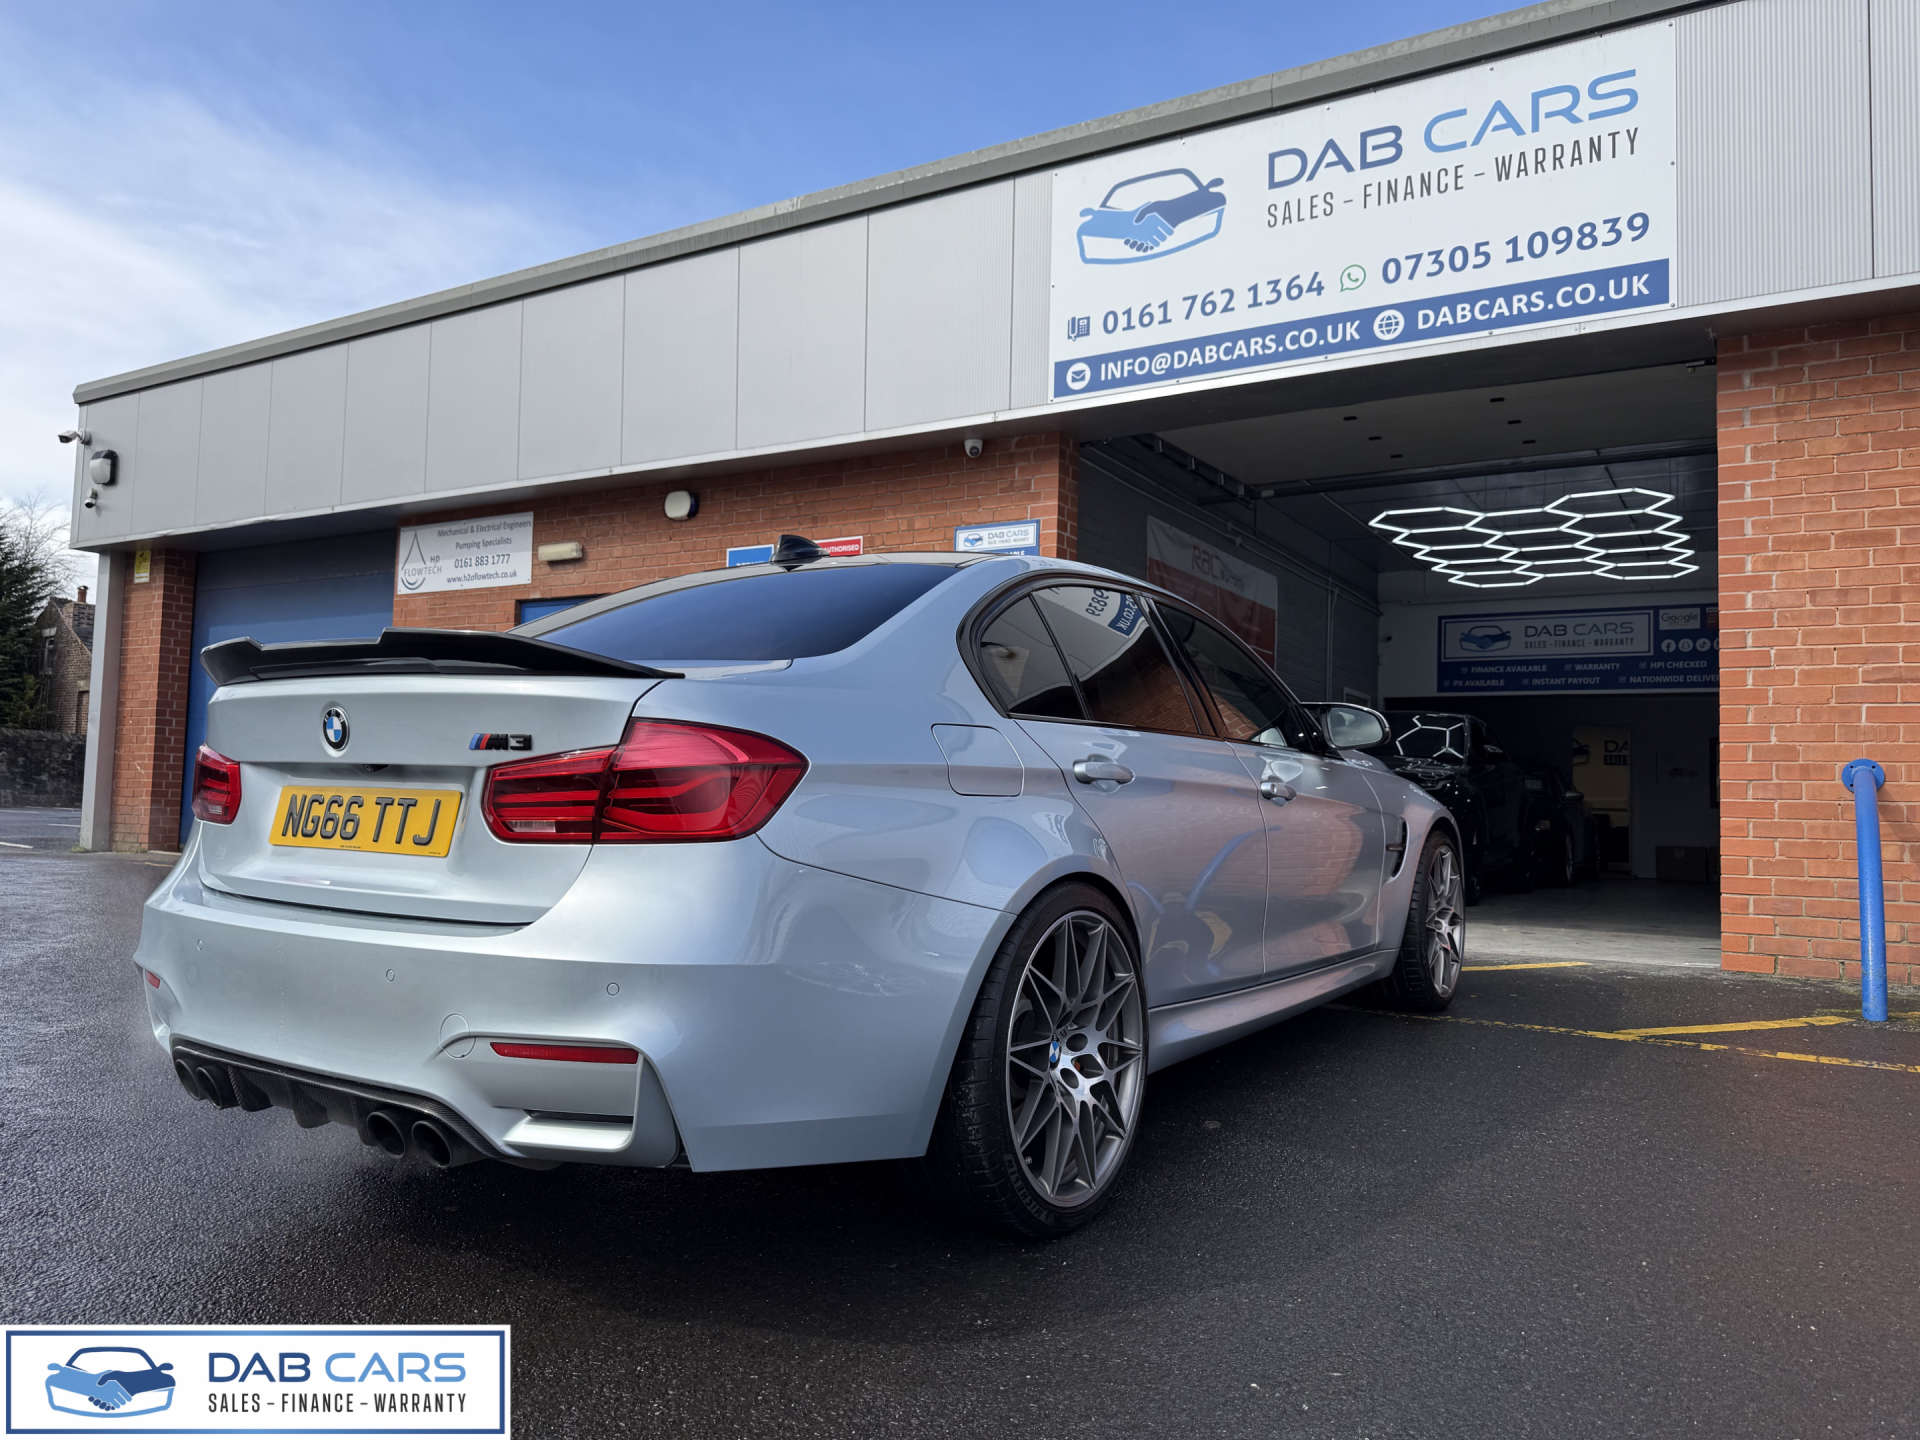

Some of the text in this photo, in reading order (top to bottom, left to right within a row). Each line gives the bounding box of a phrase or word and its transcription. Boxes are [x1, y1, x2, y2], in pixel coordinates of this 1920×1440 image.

[1267, 69, 1638, 190] DAB CARS
[1267, 190, 1334, 229] SALES
[1363, 164, 1465, 209] FINANCE
[1495, 126, 1640, 182] WARRANTY
[1381, 211, 1651, 286] 07305 109839
[1102, 271, 1325, 335] 0161 762 1364
[1417, 272, 1650, 331] DABCARS.CO.UK
[1100, 319, 1361, 384] INFO@DABCARS.CO.UK
[437, 519, 532, 537] Mechanical & Electrical Engineers
[455, 537, 513, 550] Pumping Specialists
[454, 553, 511, 569] 0161 883 1777
[404, 565, 442, 577] FLOWTECH
[1524, 622, 1634, 638] DAB CARS
[1650, 660, 1708, 669] HPI CHECKED
[1532, 676, 1600, 686] INSTANT PAYOUT
[1629, 674, 1685, 684] NATIONWIDE
[281, 793, 442, 846] NG66 TTJ
